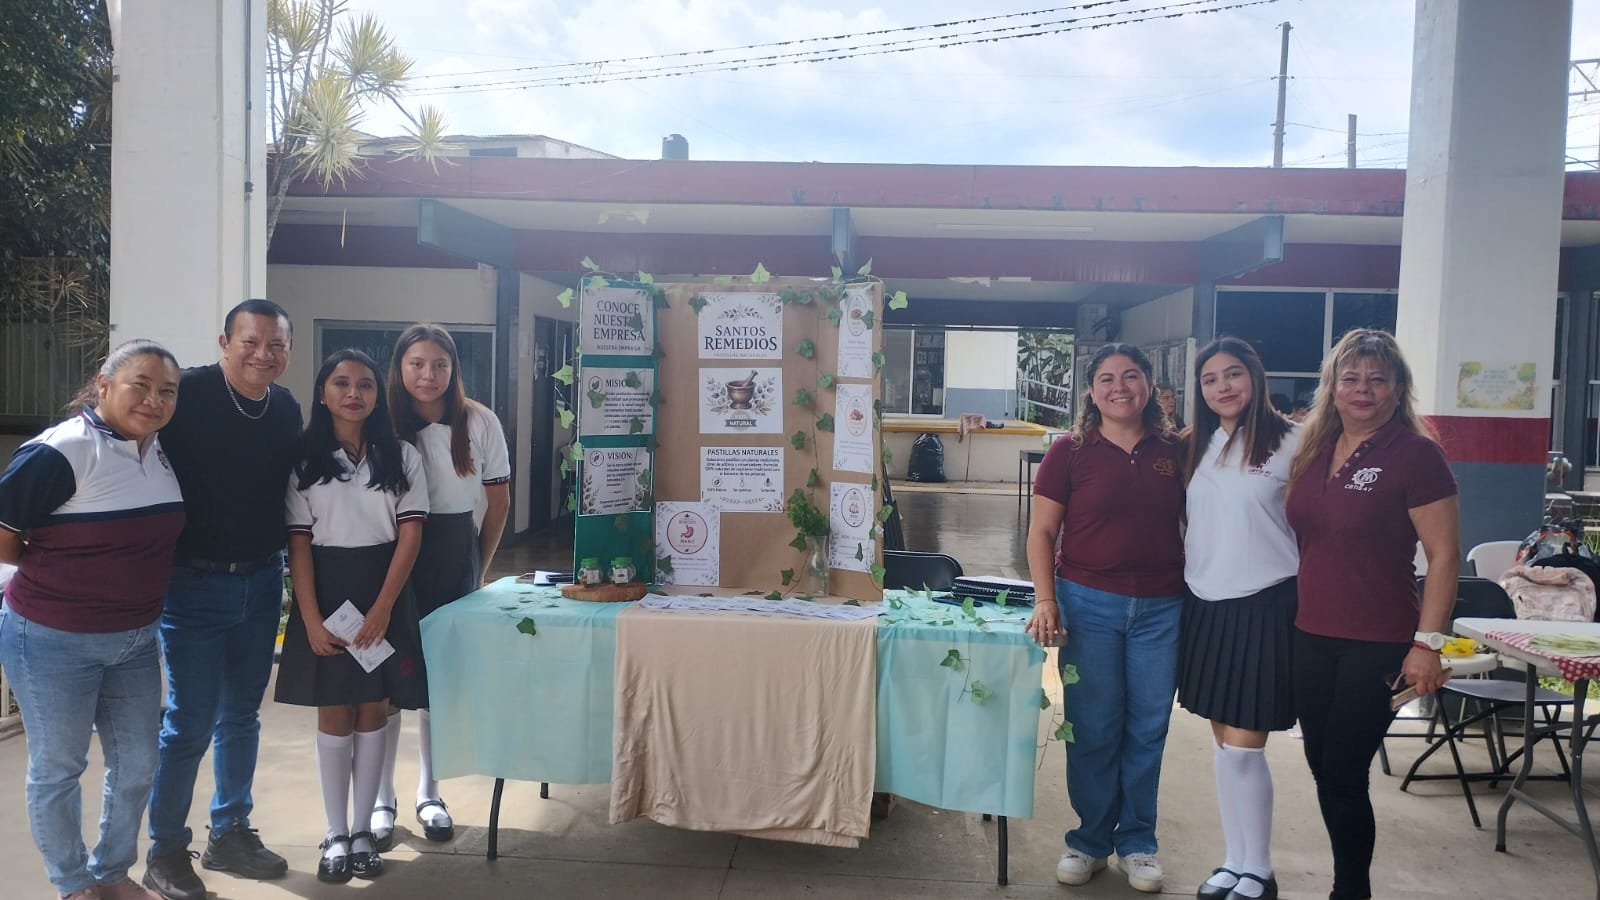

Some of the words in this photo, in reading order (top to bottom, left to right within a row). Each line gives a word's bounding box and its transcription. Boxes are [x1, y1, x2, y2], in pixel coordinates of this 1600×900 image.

[597, 300, 640, 314] CONOCE
[594, 314, 640, 327] NUEST
[593, 328, 646, 341] EMPRESA
[715, 325, 766, 337] SANTOS
[704, 336, 778, 351] REMEDIOS
[707, 448, 741, 456] PASTILLAS
[741, 448, 779, 456] NATURALES
